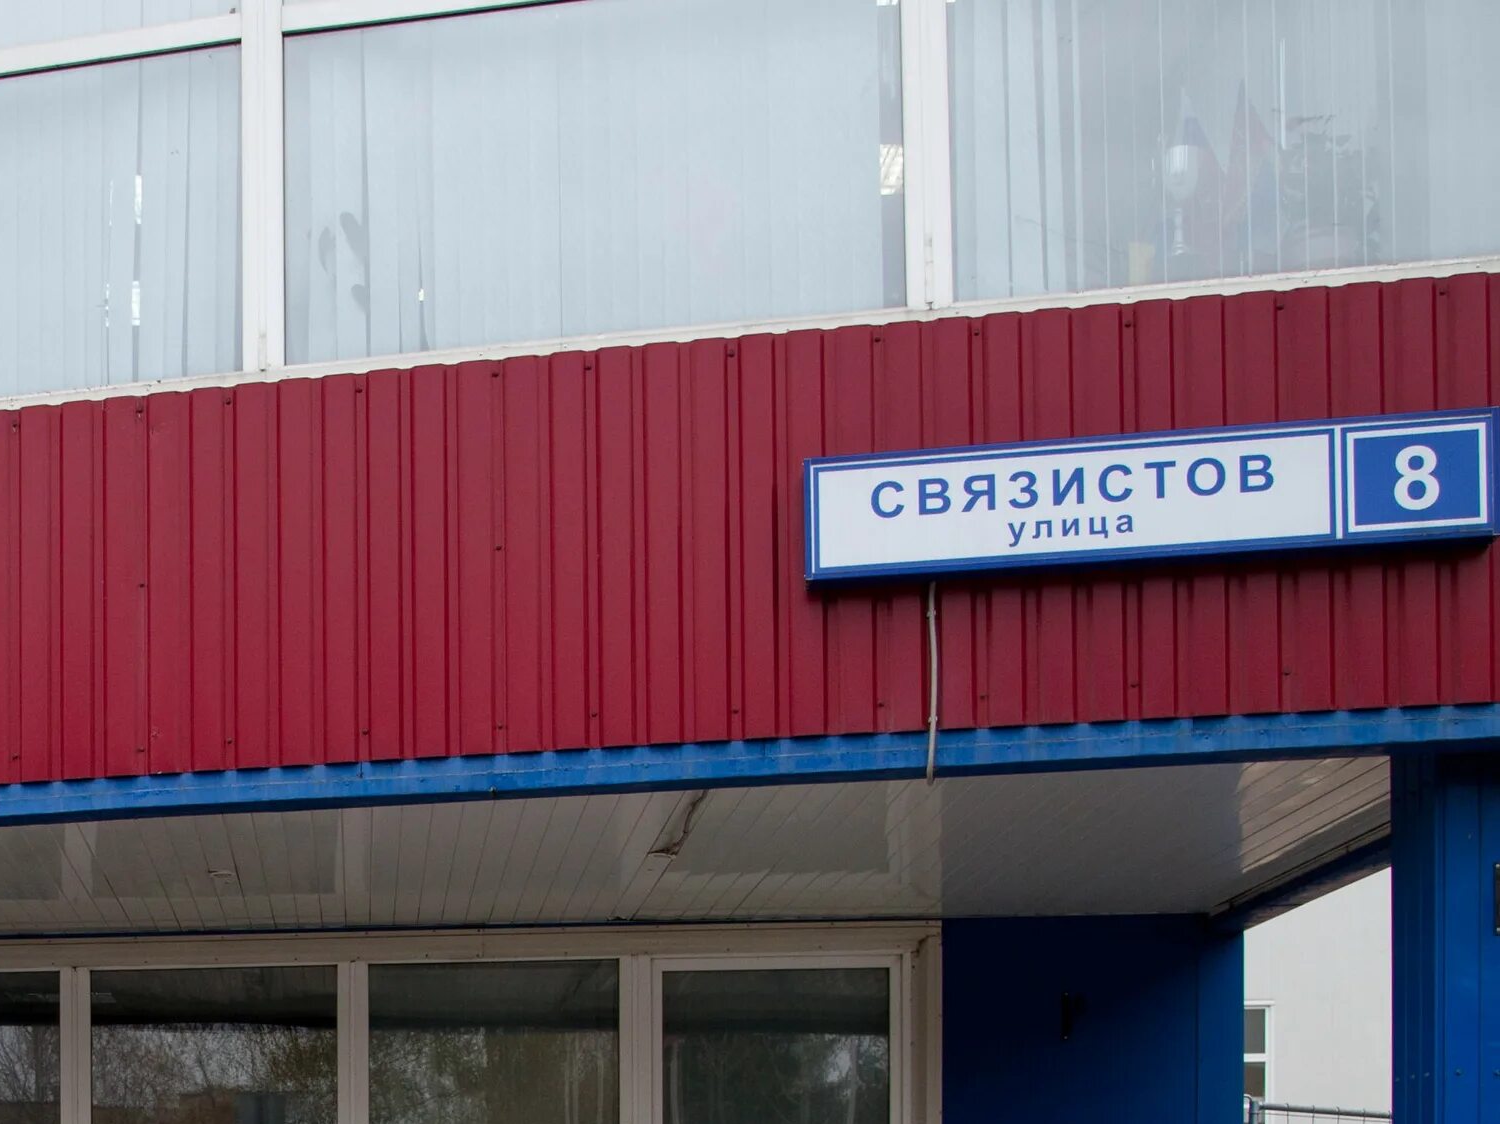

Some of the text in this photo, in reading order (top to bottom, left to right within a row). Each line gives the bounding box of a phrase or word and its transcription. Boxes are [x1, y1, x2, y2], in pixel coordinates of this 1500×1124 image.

[870, 453, 1276, 519] СВЯЗИСТОВ
[1393, 445, 1440, 510] 8
[1007, 512, 1134, 546] улица
